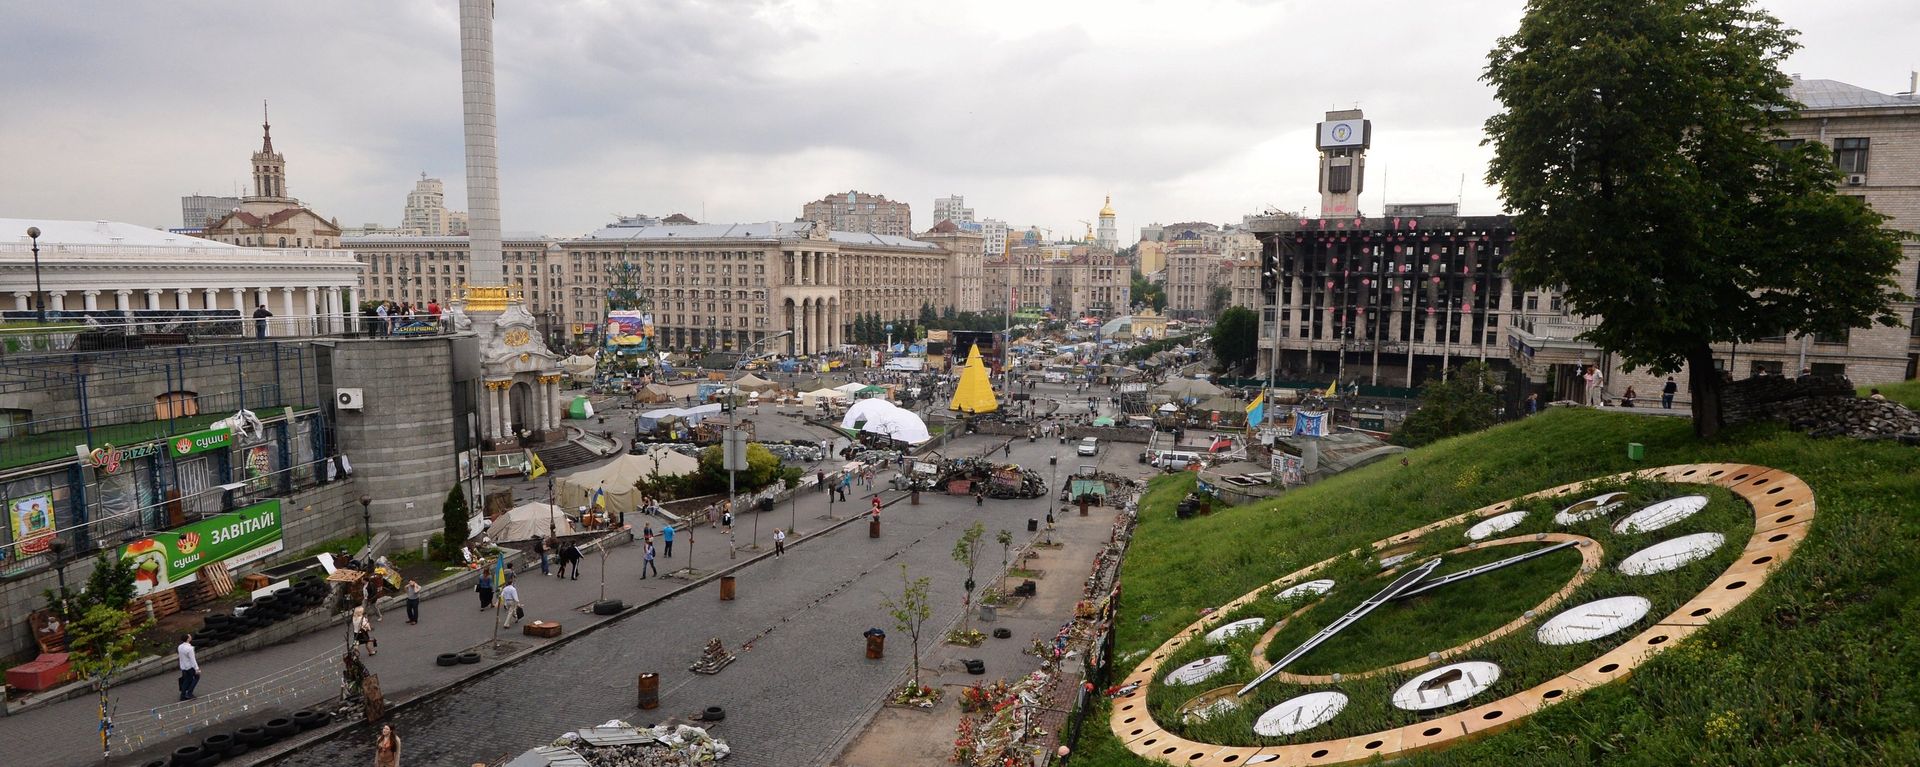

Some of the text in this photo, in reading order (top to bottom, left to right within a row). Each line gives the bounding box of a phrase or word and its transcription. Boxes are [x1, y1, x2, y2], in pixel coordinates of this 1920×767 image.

[91, 443, 159, 473] Solo PIZZA
[211, 511, 275, 545] ЗАВІТАЙ!
[173, 551, 206, 568] суши
